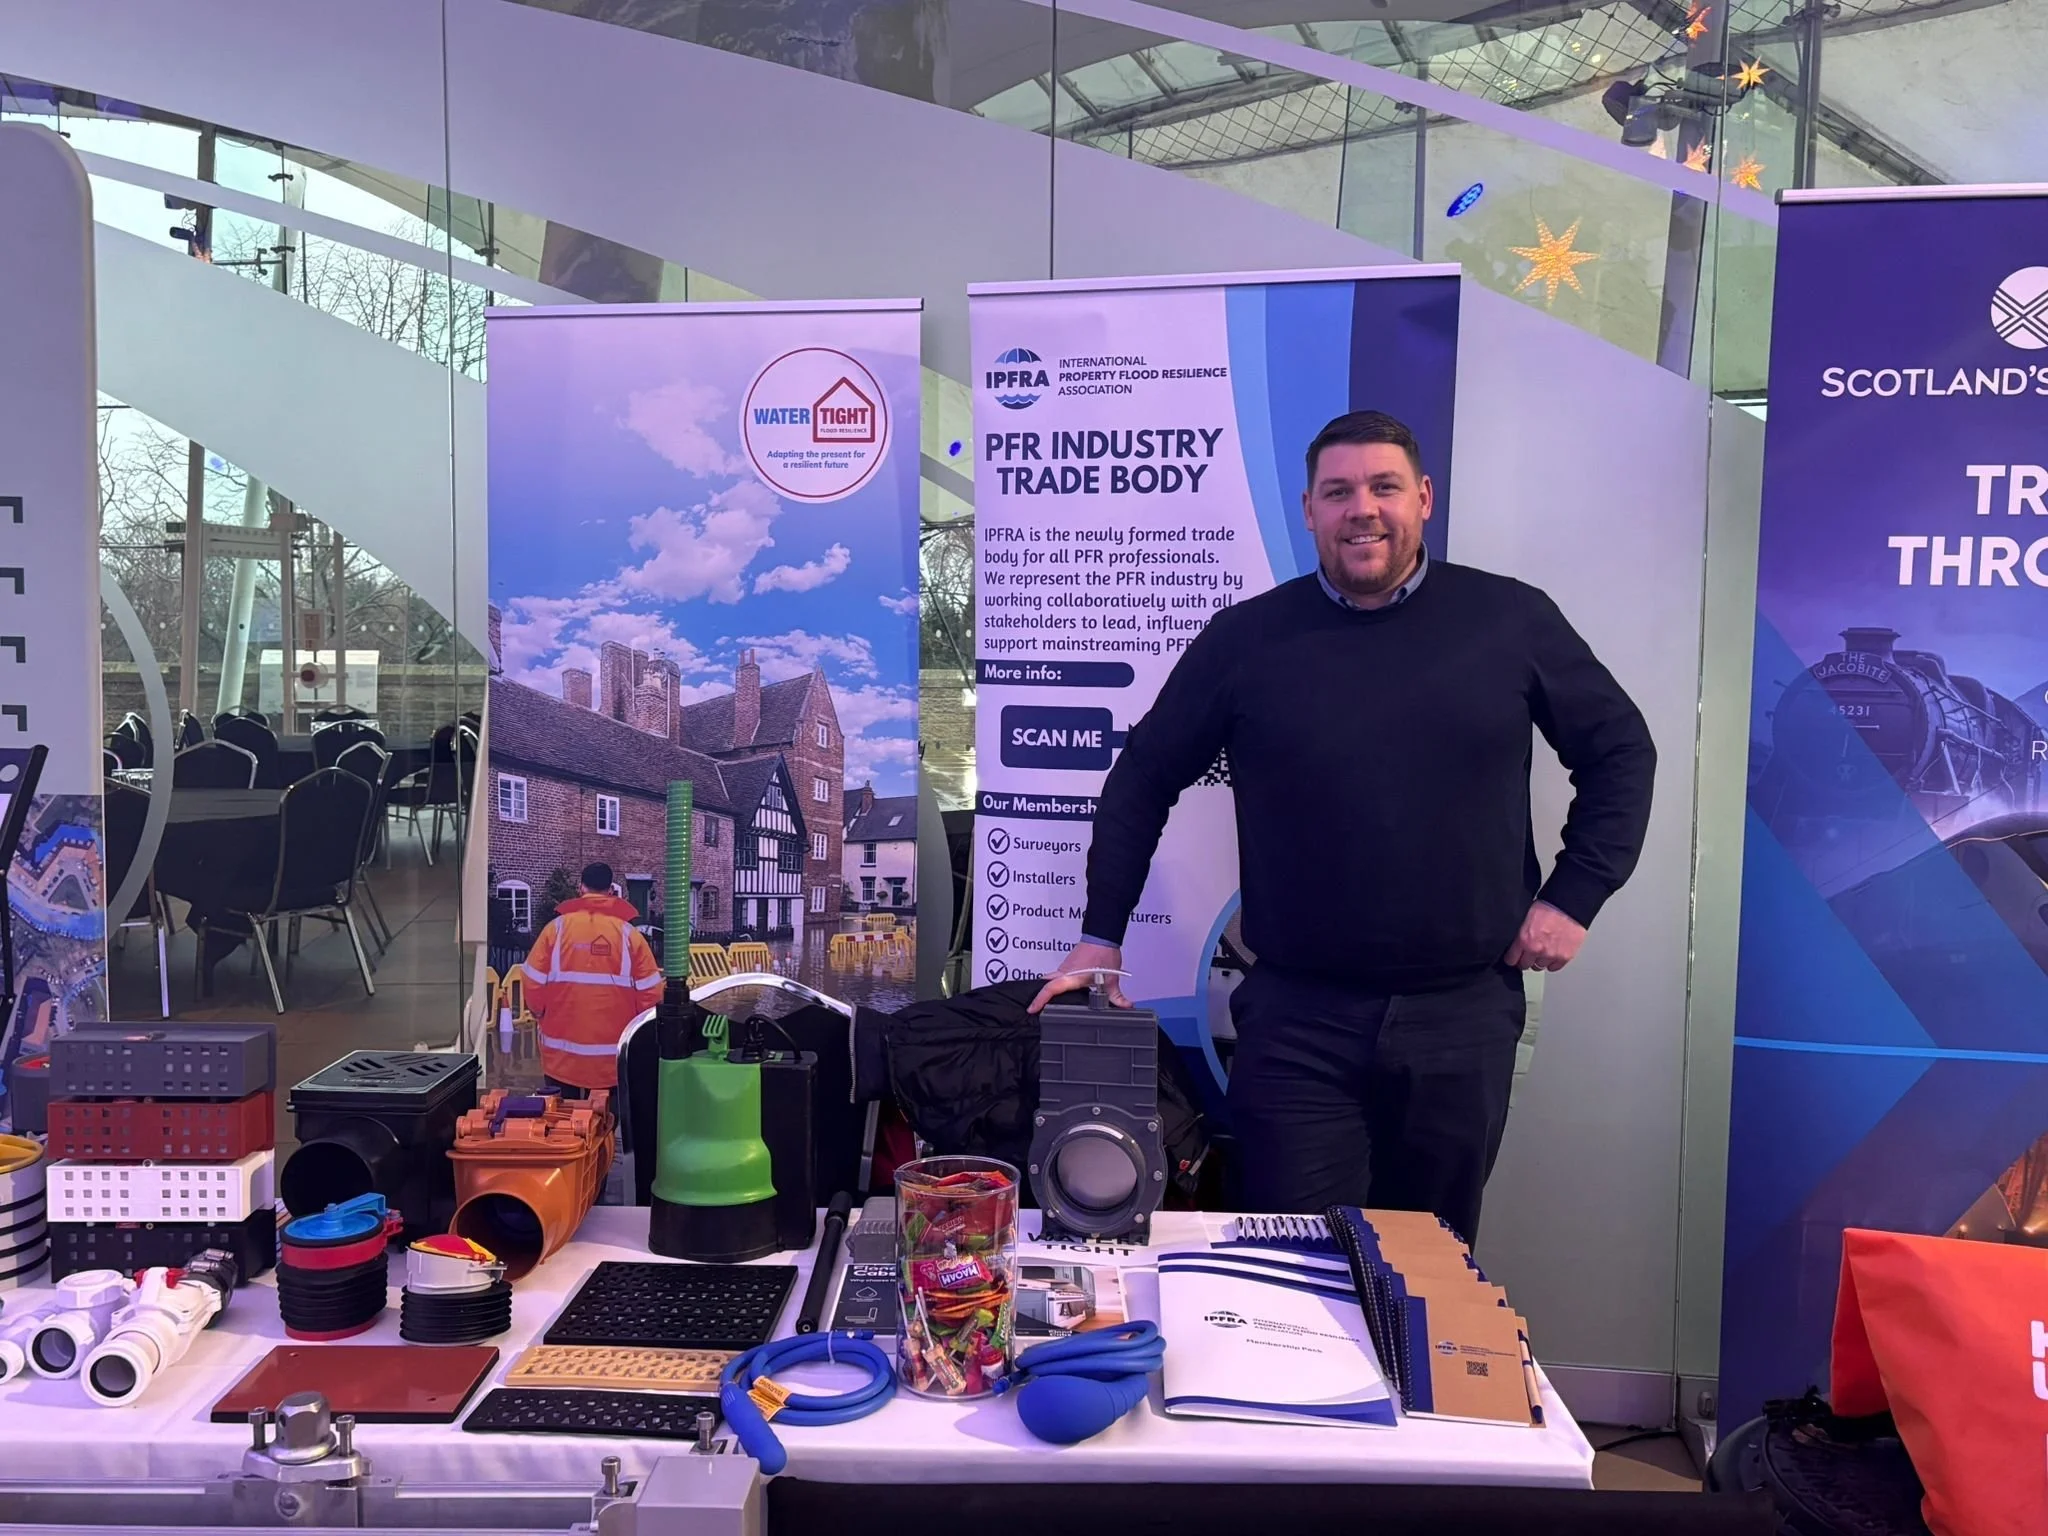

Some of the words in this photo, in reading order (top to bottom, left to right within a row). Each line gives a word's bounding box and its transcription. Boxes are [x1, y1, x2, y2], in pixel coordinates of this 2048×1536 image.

[1059, 356, 1147, 368] INTERNATIONAL
[986, 370, 1049, 388] IPFRA
[1059, 371, 1116, 382] PROPERTY
[1119, 370, 1159, 380] FLOOD
[1162, 368, 1227, 378] RESILIENCE
[1058, 384, 1132, 395] ASSOCIATION
[754, 408, 810, 424] WATER
[820, 408, 868, 424] TIGHT
[986, 433, 1042, 461] PFR
[1052, 428, 1223, 459] INDUSTRY
[767, 451, 804, 459] Adapting
[997, 467, 1099, 495] TRADE
[1111, 464, 1208, 494] BODY
[1966, 465, 2048, 515] TR
[984, 529, 1025, 542] IPFRA
[1029, 529, 1041, 541] is
[1046, 528, 1070, 541] the
[1075, 528, 1124, 544] newly
[1128, 527, 1186, 545] formed
[1192, 527, 1234, 541] trade
[985, 549, 1018, 567] body
[1022, 549, 1045, 567] for
[1050, 549, 1070, 563] all
[1074, 550, 1103, 563] PFR
[1109, 548, 1219, 567] professionals.
[984, 572, 1005, 585] We
[1009, 573, 1080, 589] represent
[1086, 572, 1110, 586] the
[1116, 572, 1145, 585] PFR
[1150, 571, 1218, 590] industry
[1223, 571, 1243, 590] by
[984, 593, 1041, 611] working
[1047, 593, 1166, 611] collaboratively
[1171, 593, 1207, 608] with
[1212, 593, 1233, 608] all
[984, 615, 1076, 629] stakeholders
[1081, 617, 1097, 629] to
[1102, 616, 1141, 632] lead,
[984, 637, 1037, 652] support
[1042, 637, 1161, 654] mainstreaming
[1840, 653, 1865, 662] THE
[985, 664, 1022, 680] More
[1026, 666, 1062, 681] info:
[1819, 663, 1886, 679] JACOBITE
[1012, 729, 1067, 747] SCAN
[1072, 731, 1102, 748] ME
[983, 795, 1008, 809] Our
[1013, 798, 1097, 814] Membersh
[1013, 838, 1081, 854] Surveyors
[1013, 871, 1076, 885] Installers
[1013, 903, 1064, 918] Product
[1043, 1243, 1136, 1256] TIGHT
[941, 1264, 978, 1284] MAOAM
[1204, 1316, 1247, 1324] IPFRA
